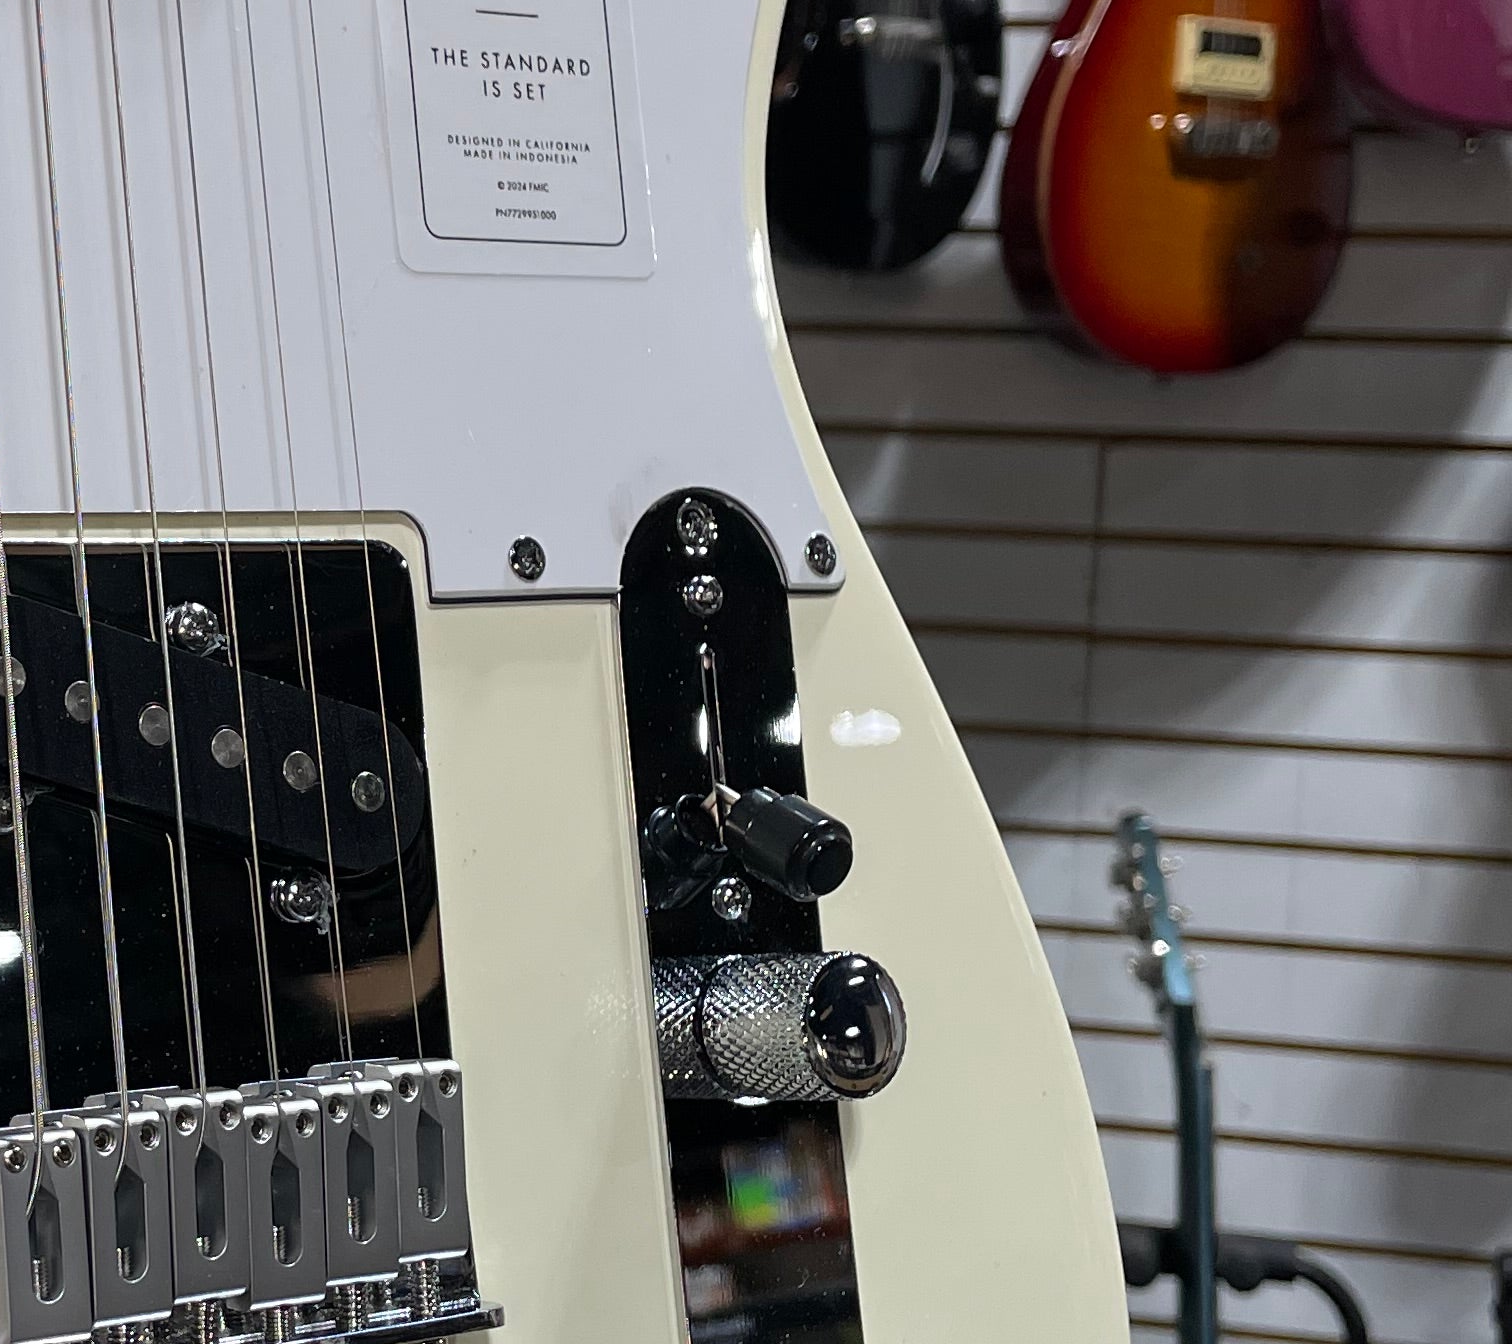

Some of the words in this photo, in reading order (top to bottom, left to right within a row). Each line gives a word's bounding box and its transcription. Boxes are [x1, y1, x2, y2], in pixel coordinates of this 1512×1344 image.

[430, 46, 469, 68] THE
[480, 50, 591, 77] STANDARD
[482, 79, 502, 99] IS
[512, 81, 547, 102] SET
[447, 133, 504, 149] DESIGNED
[507, 138, 521, 148] IN
[524, 138, 591, 153] CALIFORNIA
[462, 148, 494, 161] MADE
[498, 150, 511, 161] IN
[515, 151, 579, 165] INDONESIA
